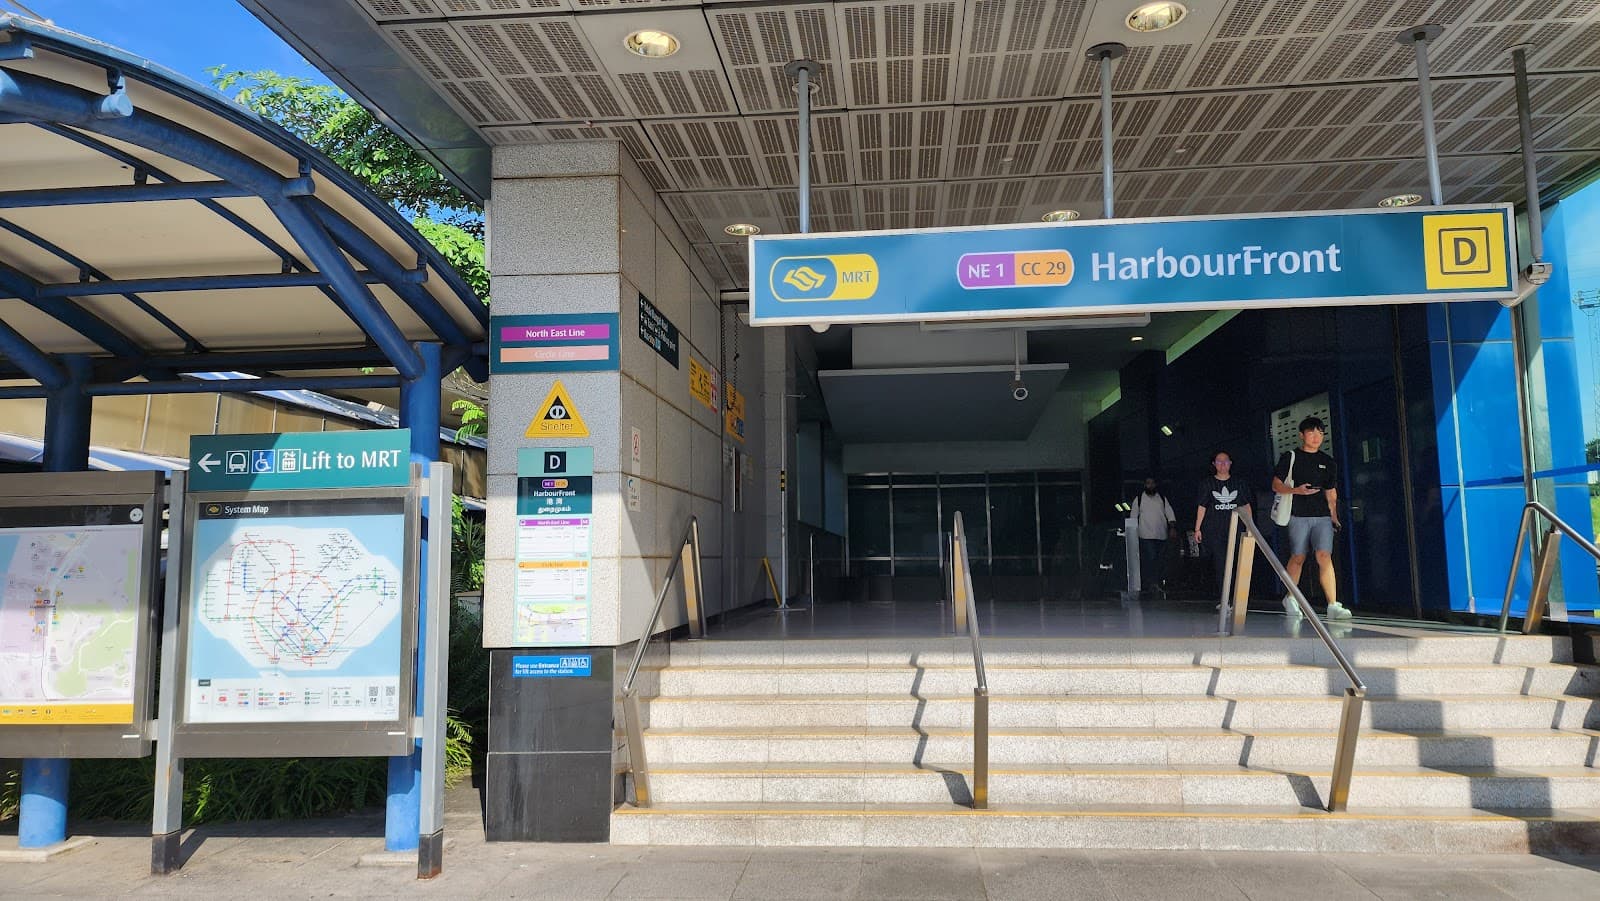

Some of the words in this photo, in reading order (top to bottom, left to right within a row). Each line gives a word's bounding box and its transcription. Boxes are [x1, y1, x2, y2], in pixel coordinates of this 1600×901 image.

[1453, 237, 1478, 265] D
[1021, 262, 1041, 276] CC
[1046, 261, 1066, 276] 29
[1091, 243, 1342, 282] HarbourFront
[842, 270, 872, 284] MRT
[968, 263, 991, 279] NE
[996, 263, 1004, 278] 1
[525, 329, 549, 338] North
[550, 329, 567, 337] East
[568, 328, 586, 337] Line
[540, 422, 573, 431] Shelter
[302, 450, 332, 470] Lift
[336, 452, 355, 469] to
[361, 449, 402, 468] MRT
[549, 454, 561, 470] D
[533, 489, 576, 497] HarbourFront
[224, 505, 251, 515] System
[252, 504, 269, 515] Map
